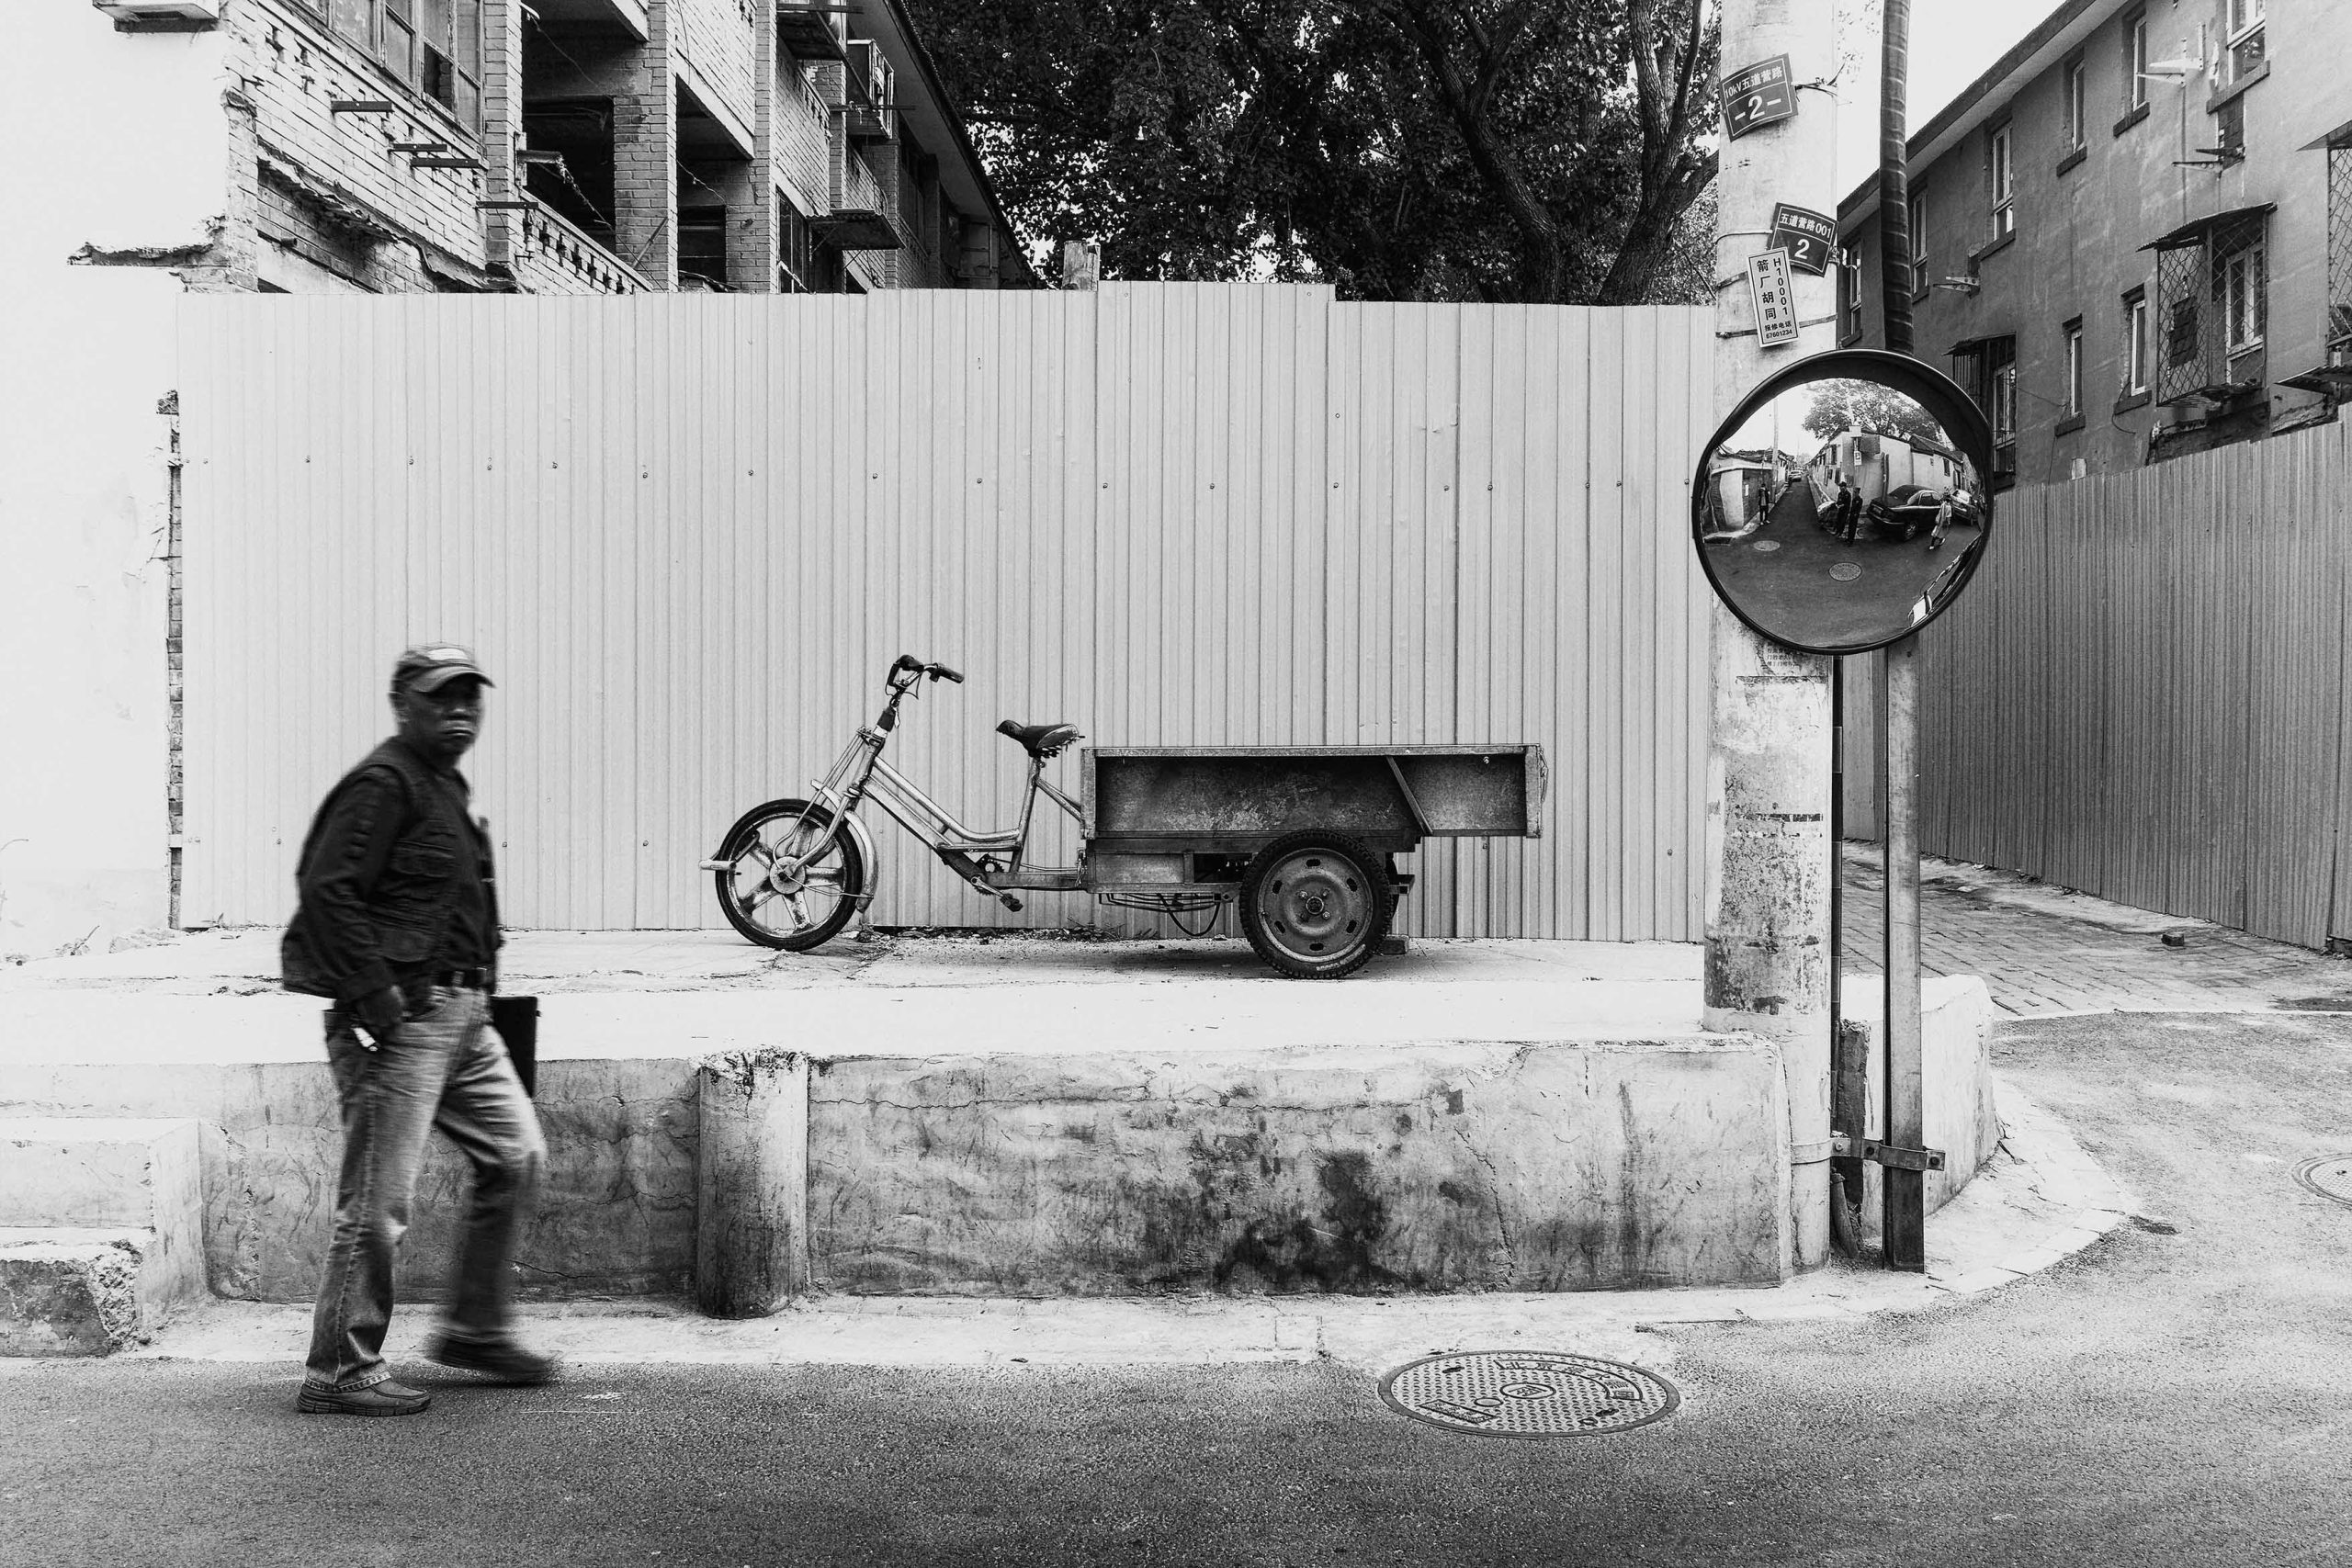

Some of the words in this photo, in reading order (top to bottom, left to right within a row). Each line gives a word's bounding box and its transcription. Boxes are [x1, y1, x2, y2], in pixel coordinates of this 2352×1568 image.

[1780, 212, 1831, 239] 五道营路001
[1794, 238, 1810, 259] 2
[1757, 259, 1777, 321] 箭厂胡同
[1773, 257, 1788, 316] H10001
[1764, 321, 1792, 332] 报修电话
